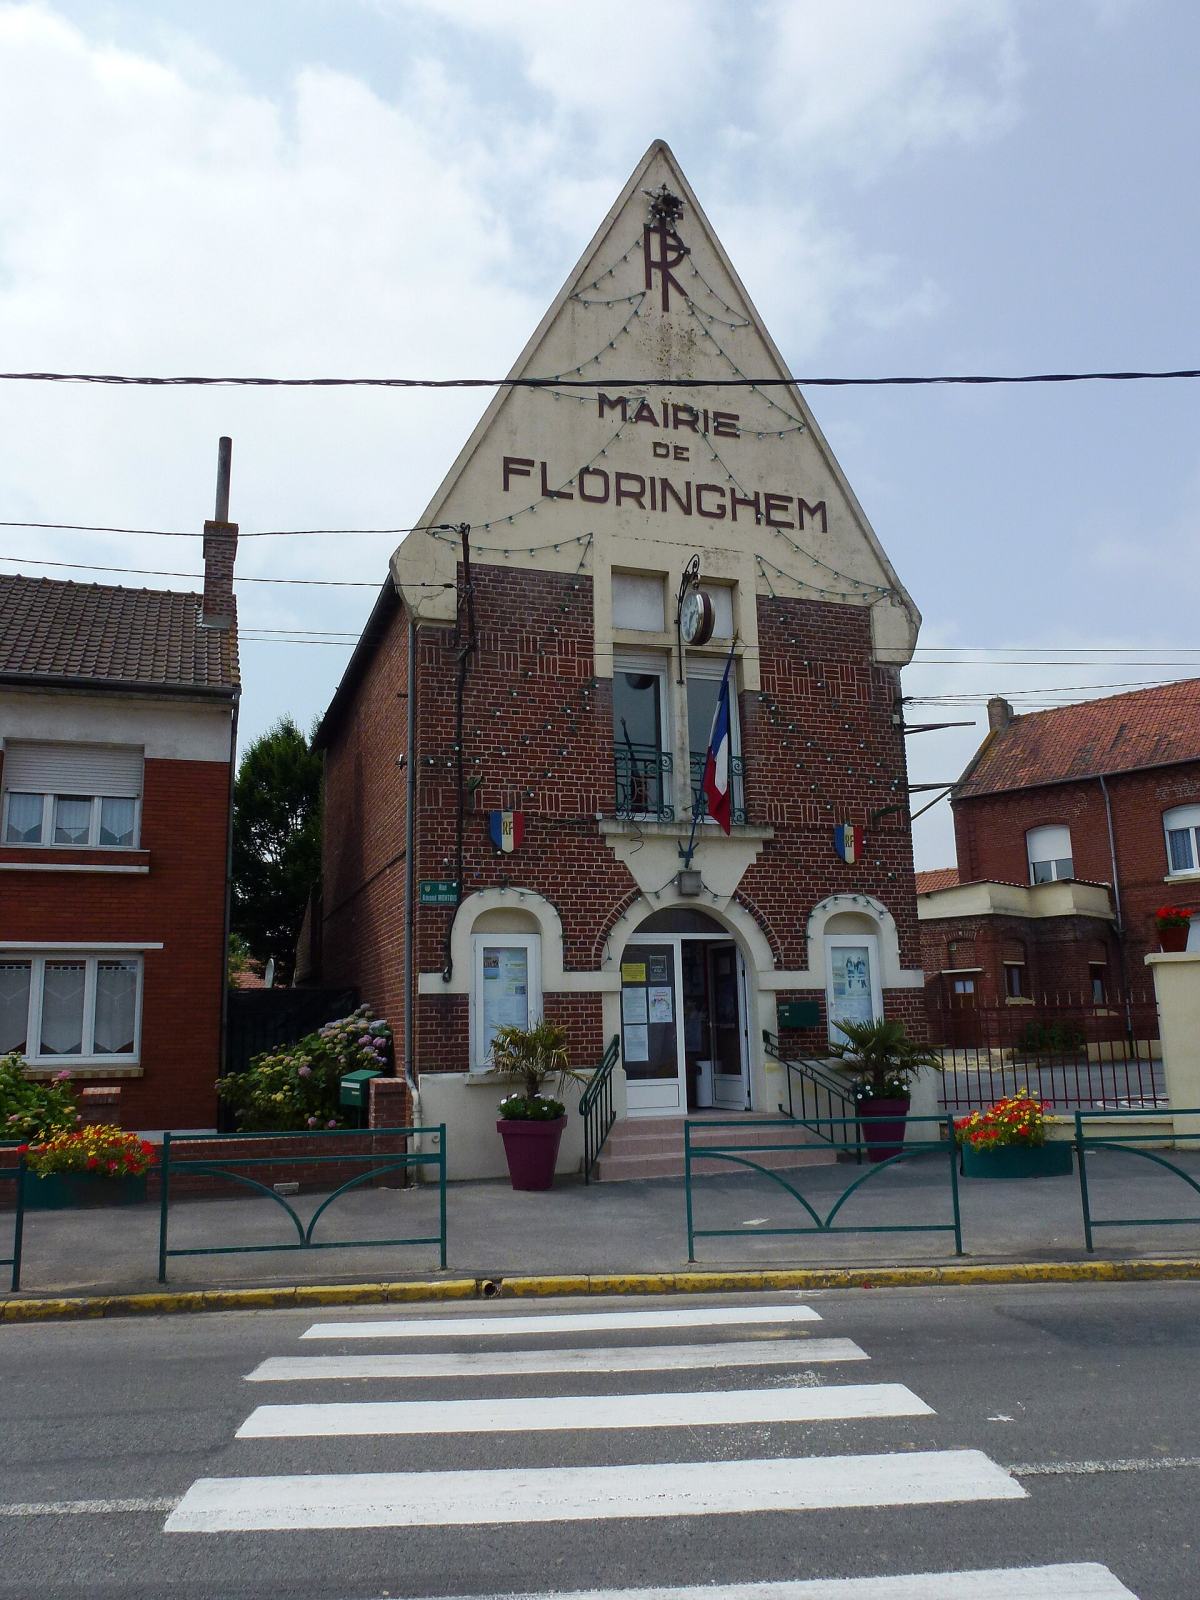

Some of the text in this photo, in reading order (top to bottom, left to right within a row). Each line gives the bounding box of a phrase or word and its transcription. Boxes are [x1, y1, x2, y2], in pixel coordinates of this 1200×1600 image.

[597, 392, 741, 439] MAIRIE
[652, 441, 690, 462] DE
[502, 456, 828, 533] FLORINGHEM
